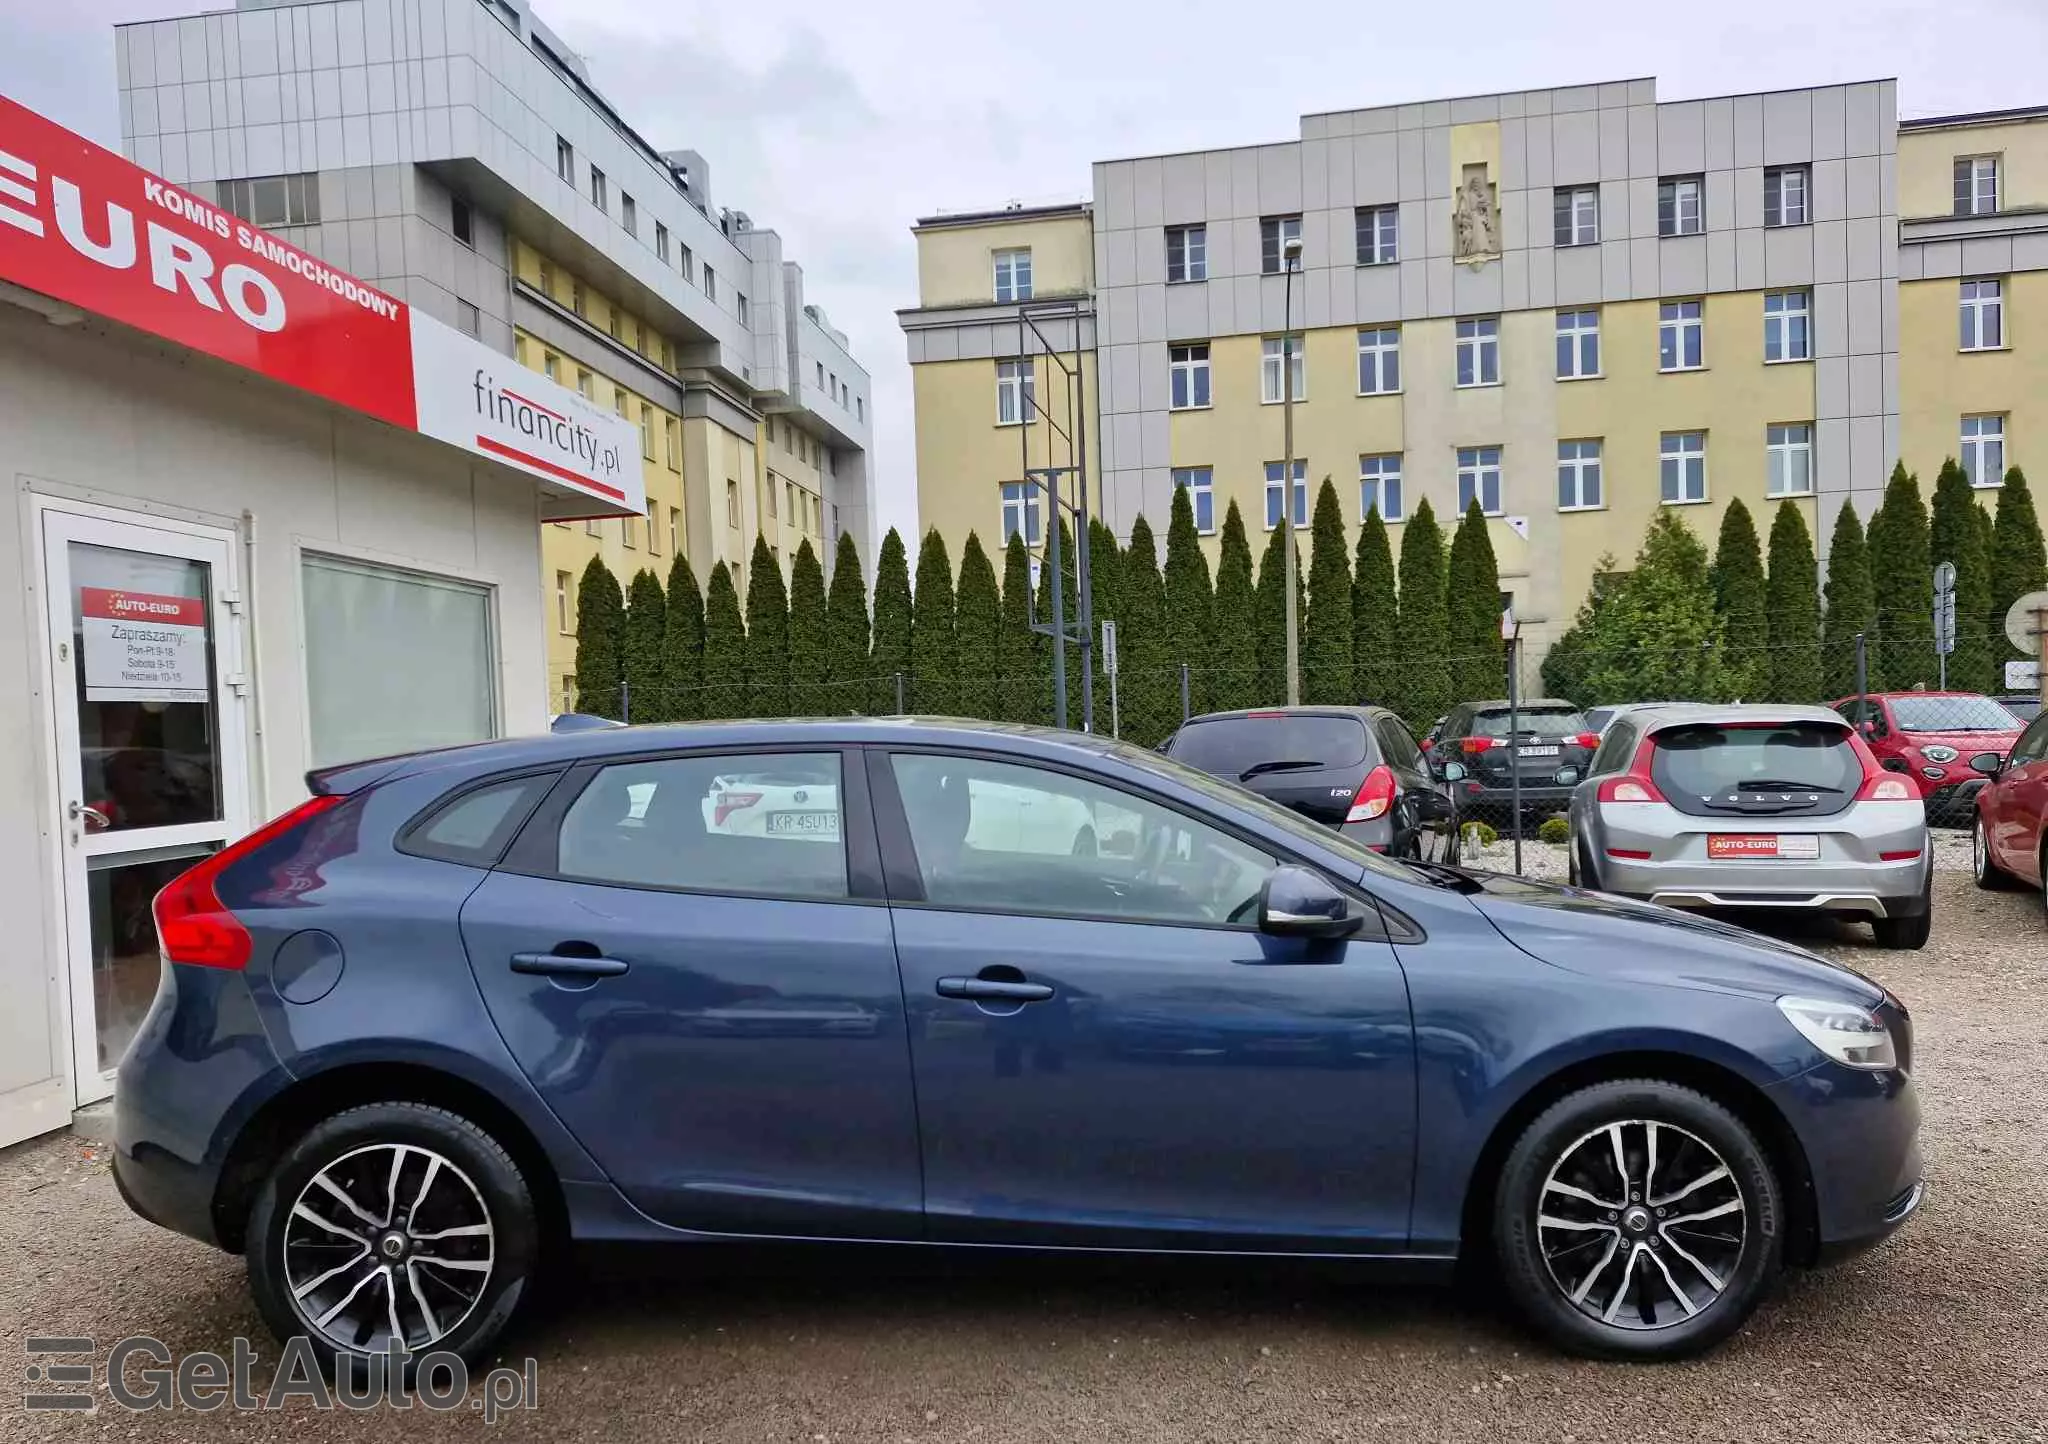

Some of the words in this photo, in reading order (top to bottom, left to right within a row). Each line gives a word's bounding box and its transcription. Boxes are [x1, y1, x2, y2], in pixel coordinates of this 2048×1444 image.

[144, 176, 231, 238] KOMIS
[237, 226, 399, 321] SAMOCHODOWY
[473, 369, 620, 474] financity.pl
[115, 599, 180, 615] AUTO-EURO
[1701, 794, 1819, 802] VOLVO
[774, 815, 793, 828] KR
[1715, 840, 1777, 849] AUTO-EURO
